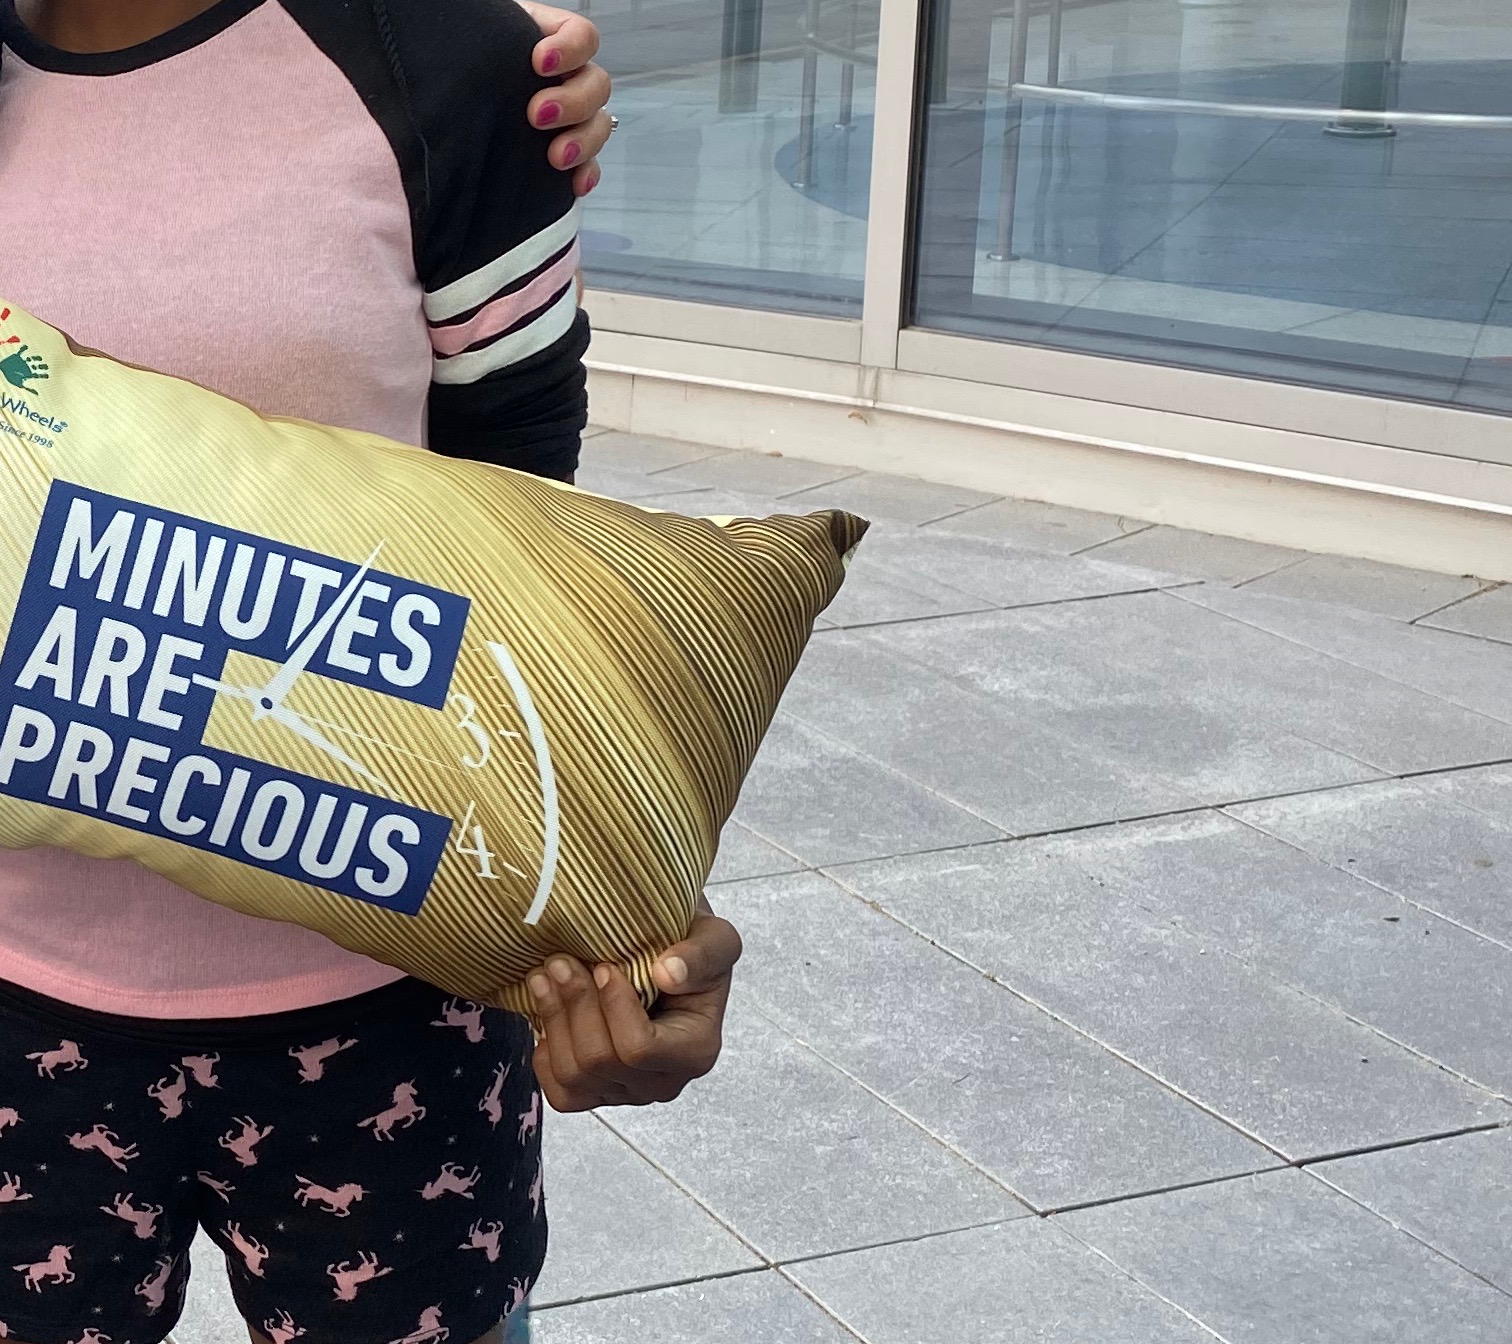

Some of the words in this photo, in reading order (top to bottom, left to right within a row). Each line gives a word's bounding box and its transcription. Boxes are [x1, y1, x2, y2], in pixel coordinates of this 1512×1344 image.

[27, 433, 55, 448] 1998
[49, 498, 441, 688] MINUTES
[14, 605, 204, 731] ARE
[449, 693, 490, 768] 3
[456, 799, 500, 879] 4
